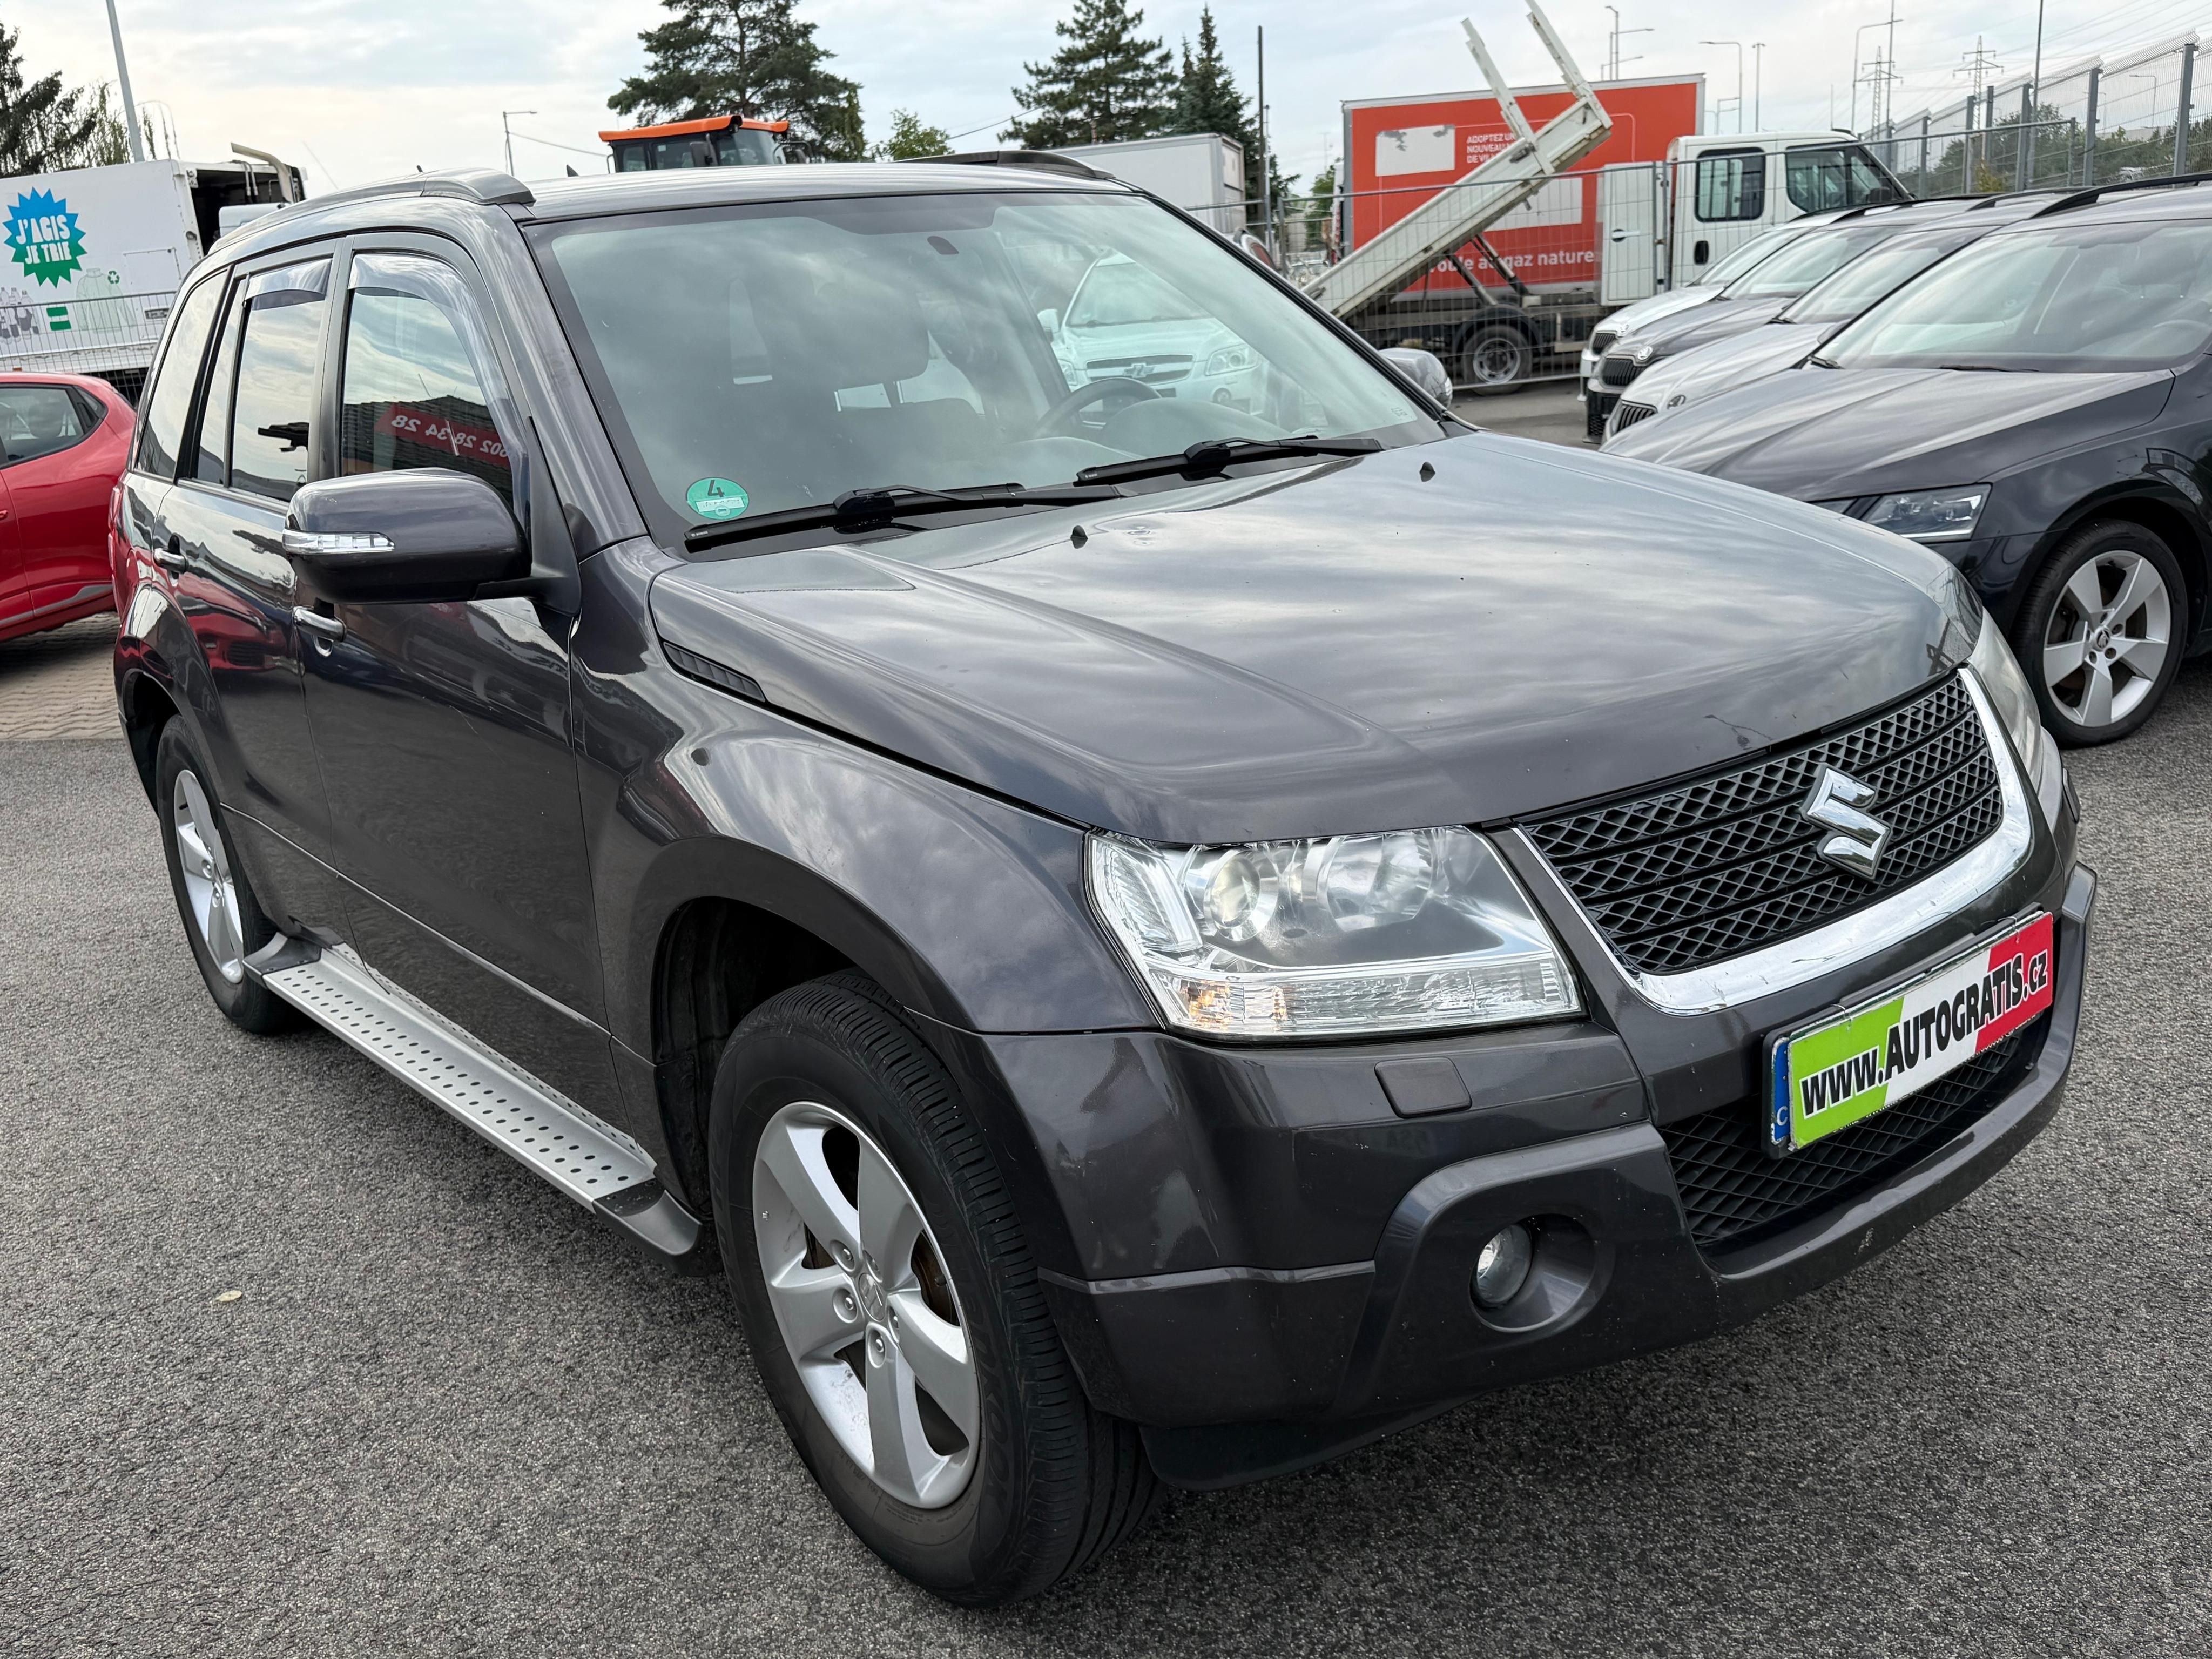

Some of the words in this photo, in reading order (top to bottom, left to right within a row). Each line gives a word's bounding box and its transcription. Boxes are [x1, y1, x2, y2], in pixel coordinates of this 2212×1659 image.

[25, 245, 41, 264] JE
[41, 241, 72, 262] TRIE
[707, 479, 725, 497] 4
